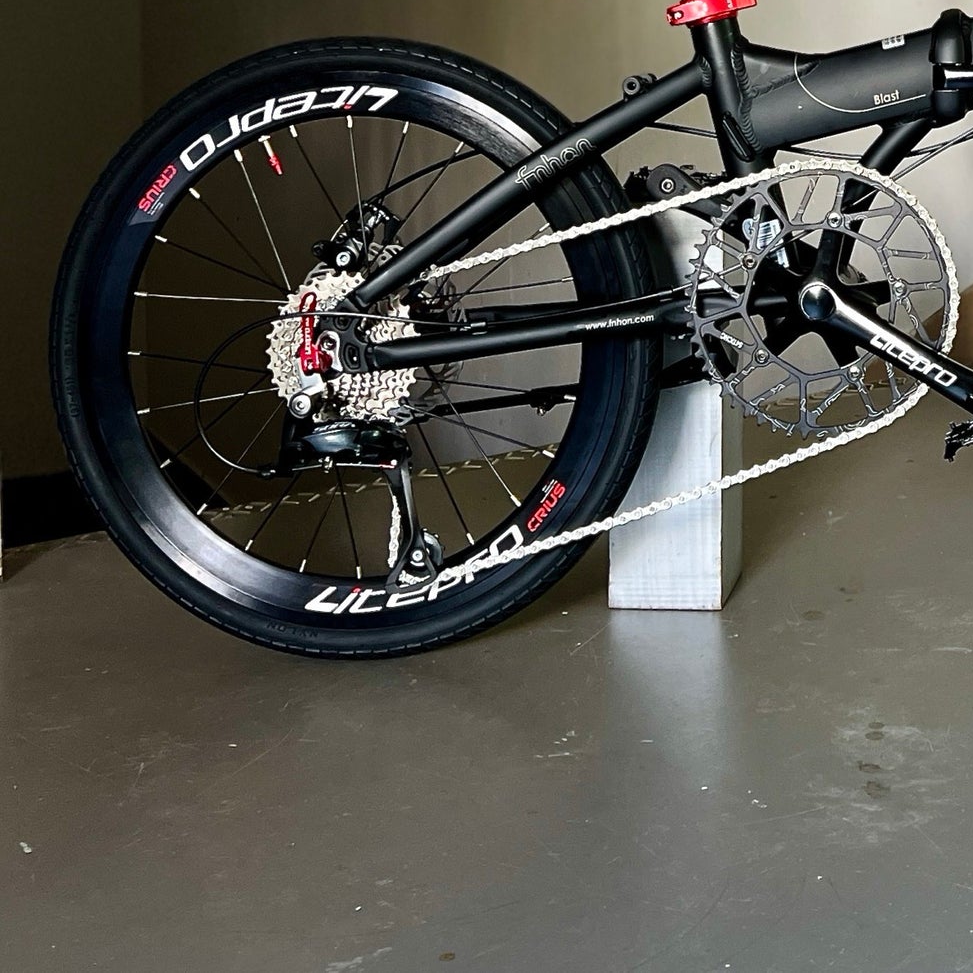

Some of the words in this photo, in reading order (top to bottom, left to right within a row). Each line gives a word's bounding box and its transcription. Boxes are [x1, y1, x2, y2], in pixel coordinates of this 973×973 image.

[873, 89, 900, 106] Blast
[137, 161, 178, 213] CRIUS
[585, 314, 655, 330] www.fnhon.com
[526, 481, 566, 533] CRIUS
